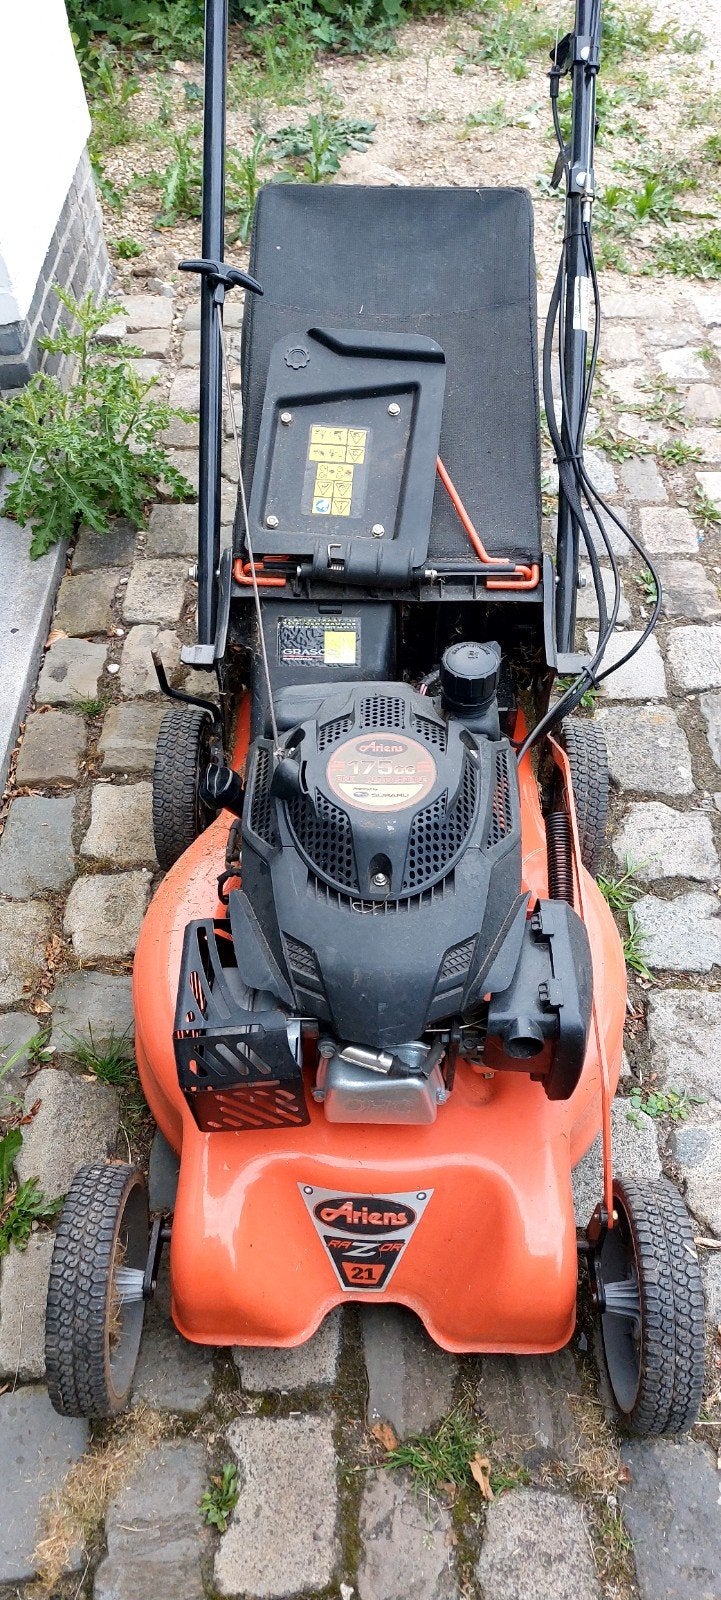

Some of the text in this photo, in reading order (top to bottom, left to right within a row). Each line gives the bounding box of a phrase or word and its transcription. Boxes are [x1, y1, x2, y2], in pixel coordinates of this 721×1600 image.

[359, 741, 404, 752] Ariens
[320, 1201, 408, 1226] Ariens
[351, 1266, 377, 1280] 21
